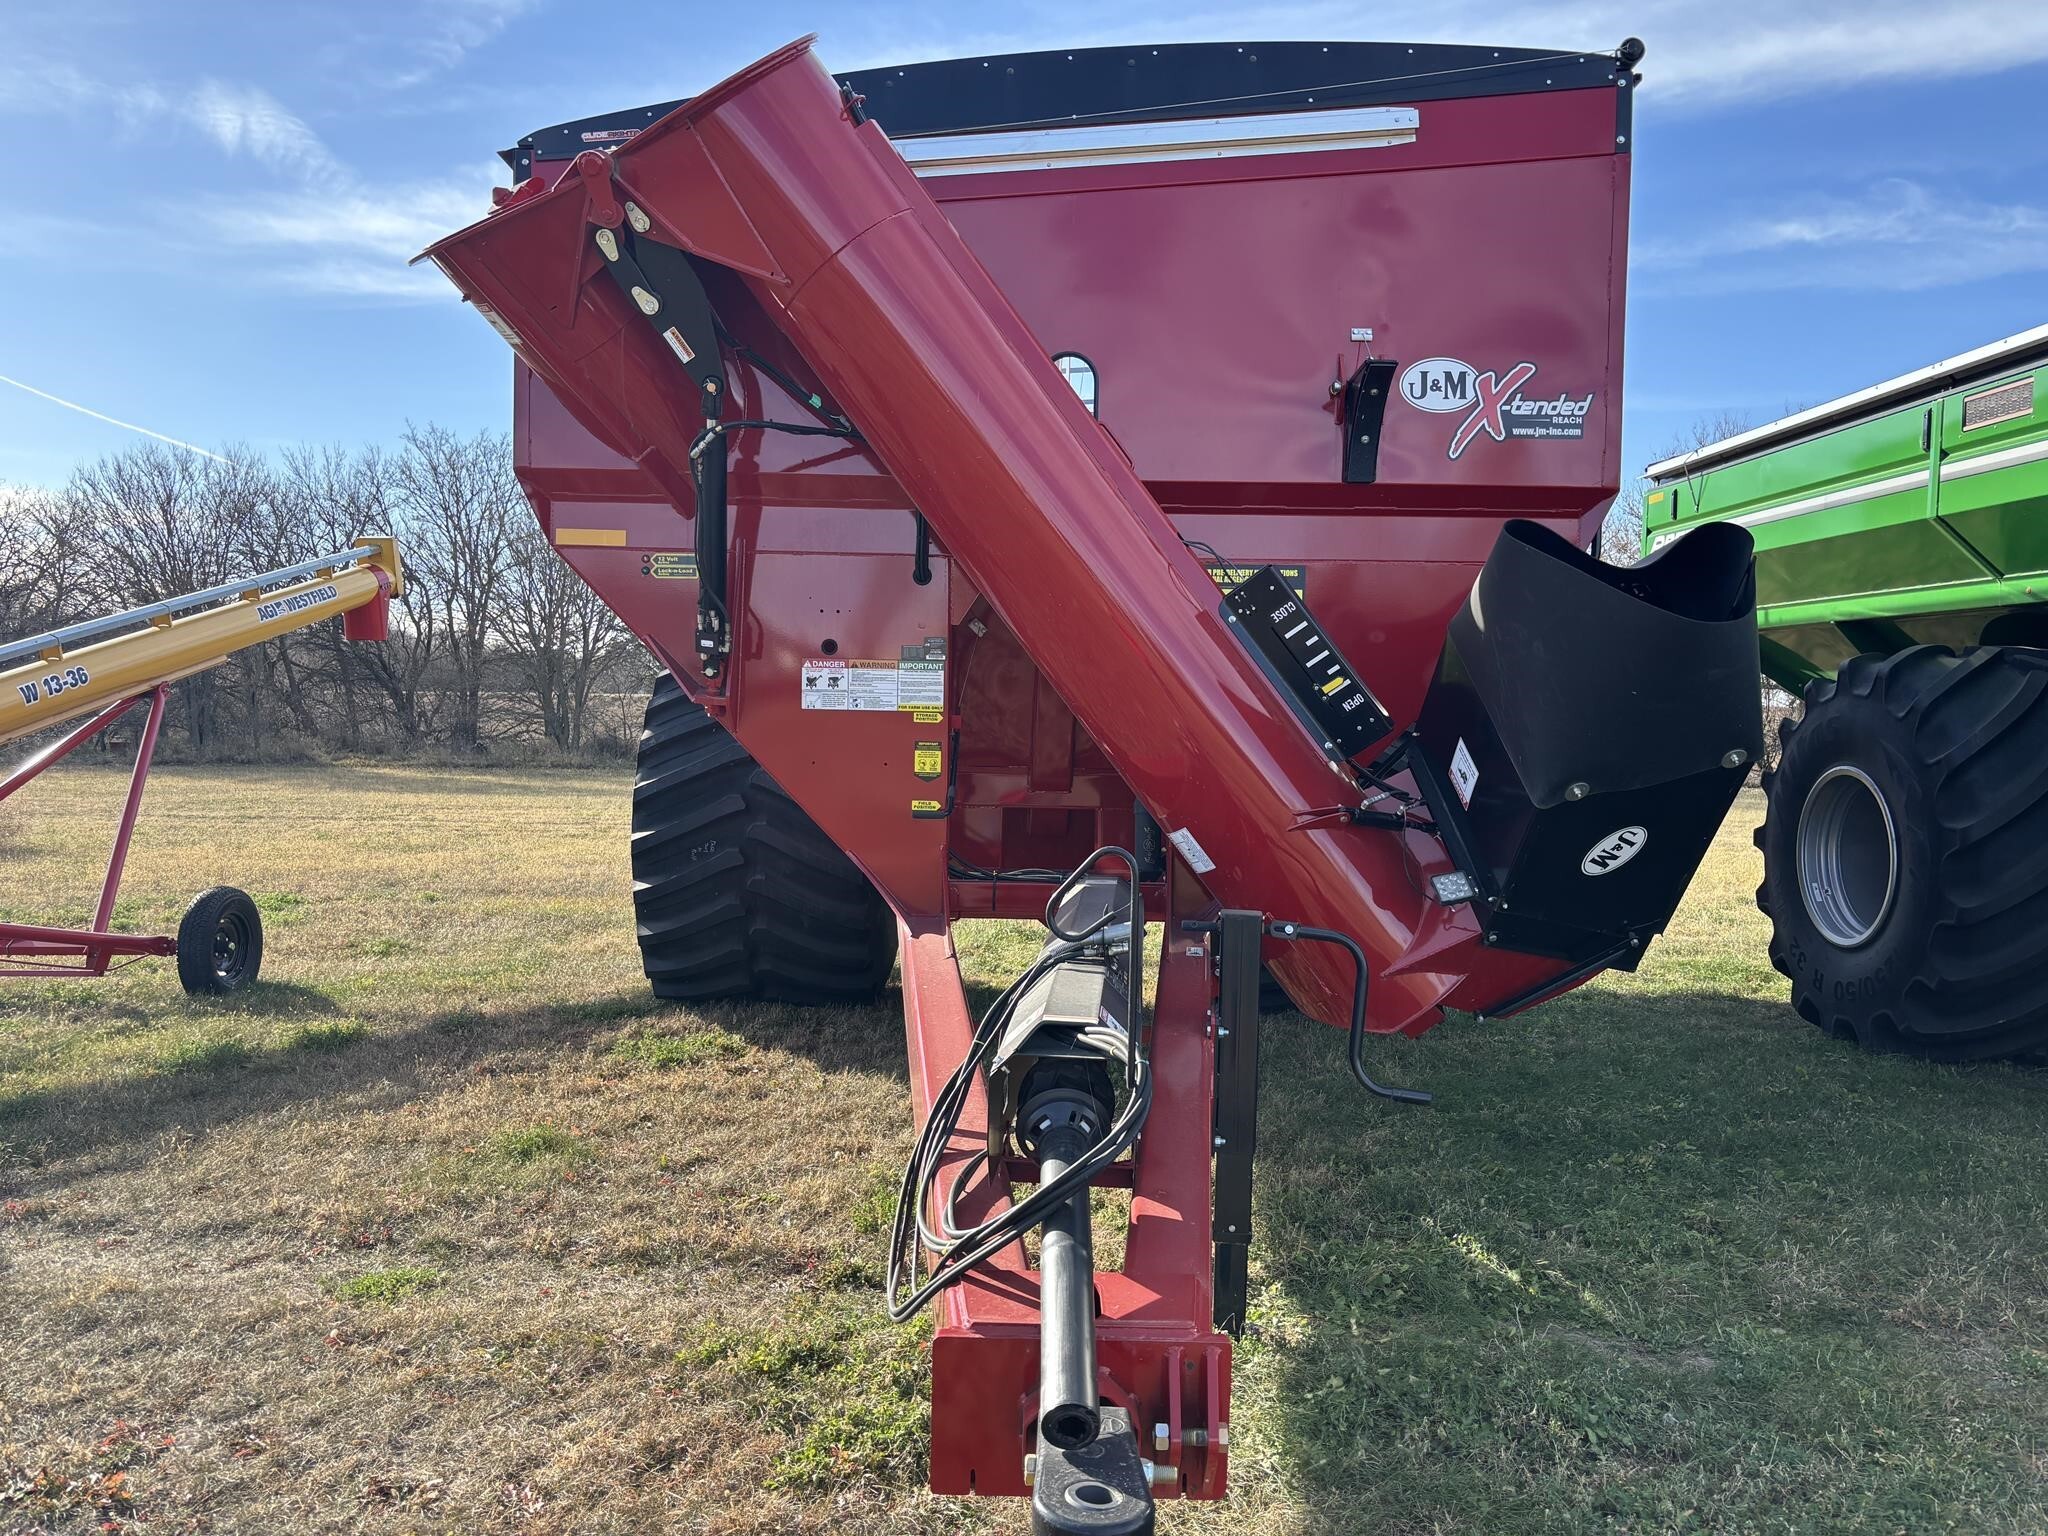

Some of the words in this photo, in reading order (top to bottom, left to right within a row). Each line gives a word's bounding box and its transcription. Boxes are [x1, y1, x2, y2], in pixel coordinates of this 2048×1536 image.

[1408, 370, 1468, 400] J&M
[1449, 362, 1595, 459] X-tended
[1552, 416, 1582, 424] REACH
[1512, 426, 1581, 438] www.jm-inc.com
[257, 601, 278, 621] AGI
[283, 585, 338, 612] WESTFIELD
[1270, 601, 1297, 624] CLOSE
[812, 660, 846, 668] DANGER
[859, 661, 896, 670] WARNING
[899, 662, 944, 670] IMPORTANT
[18, 682, 40, 705] W
[42, 666, 89, 696] 13-36
[1342, 693, 1365, 712] OPEN
[1587, 830, 1639, 870] J&M
